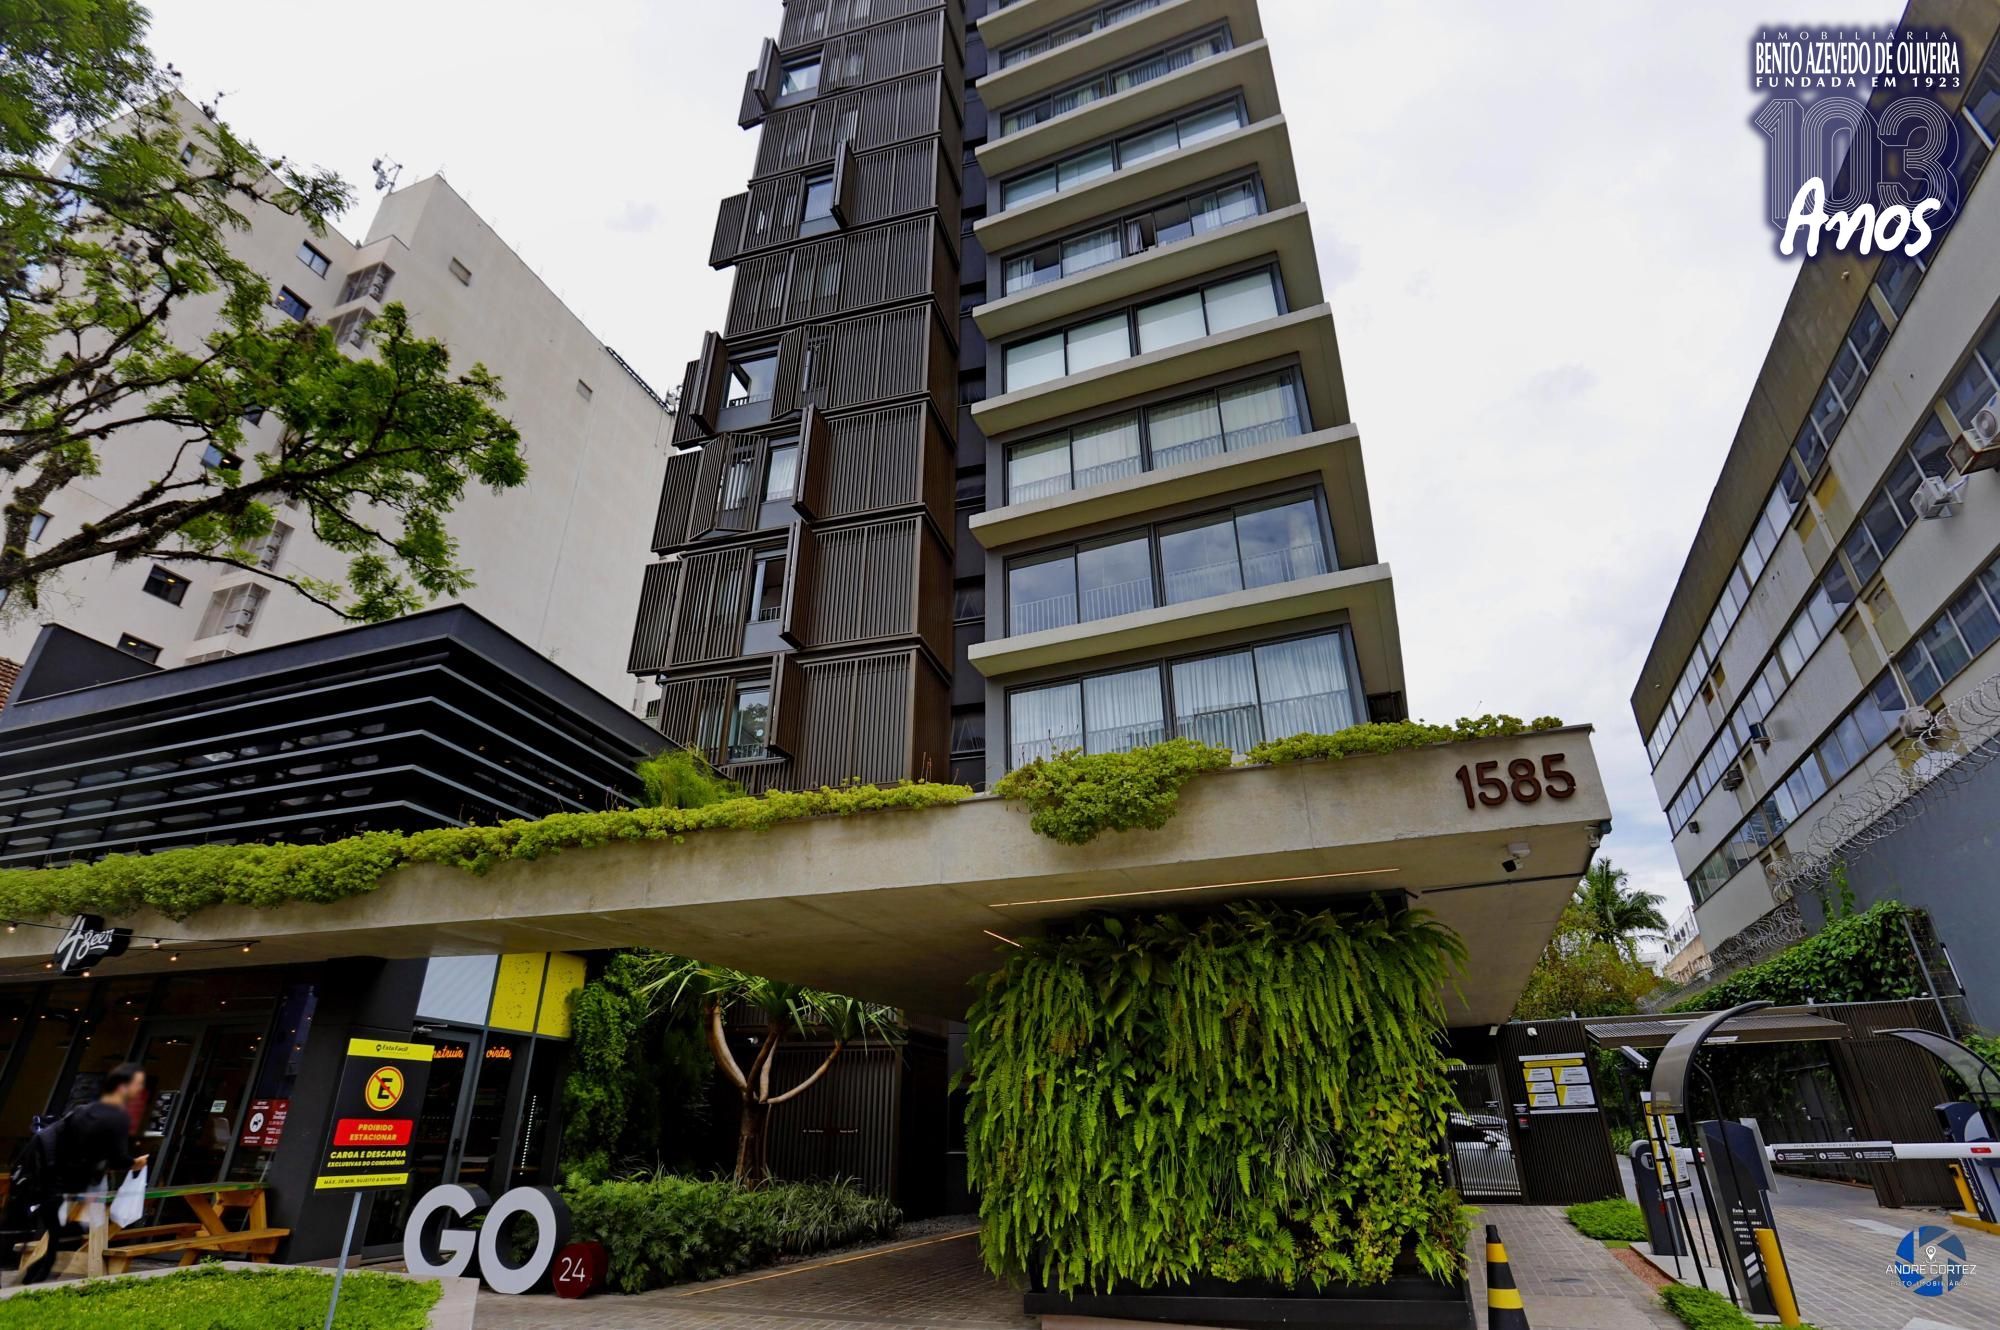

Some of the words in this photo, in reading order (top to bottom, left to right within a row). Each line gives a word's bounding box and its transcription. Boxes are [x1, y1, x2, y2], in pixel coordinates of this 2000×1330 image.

[1456, 753, 1576, 809] 1585
[349, 1133, 397, 1141] ESTACIONAR
[330, 1151, 359, 1159] CARGA
[366, 1150, 406, 1158] DESCARGA
[403, 1184, 557, 1295] GO
[559, 1257, 586, 1282] 24
